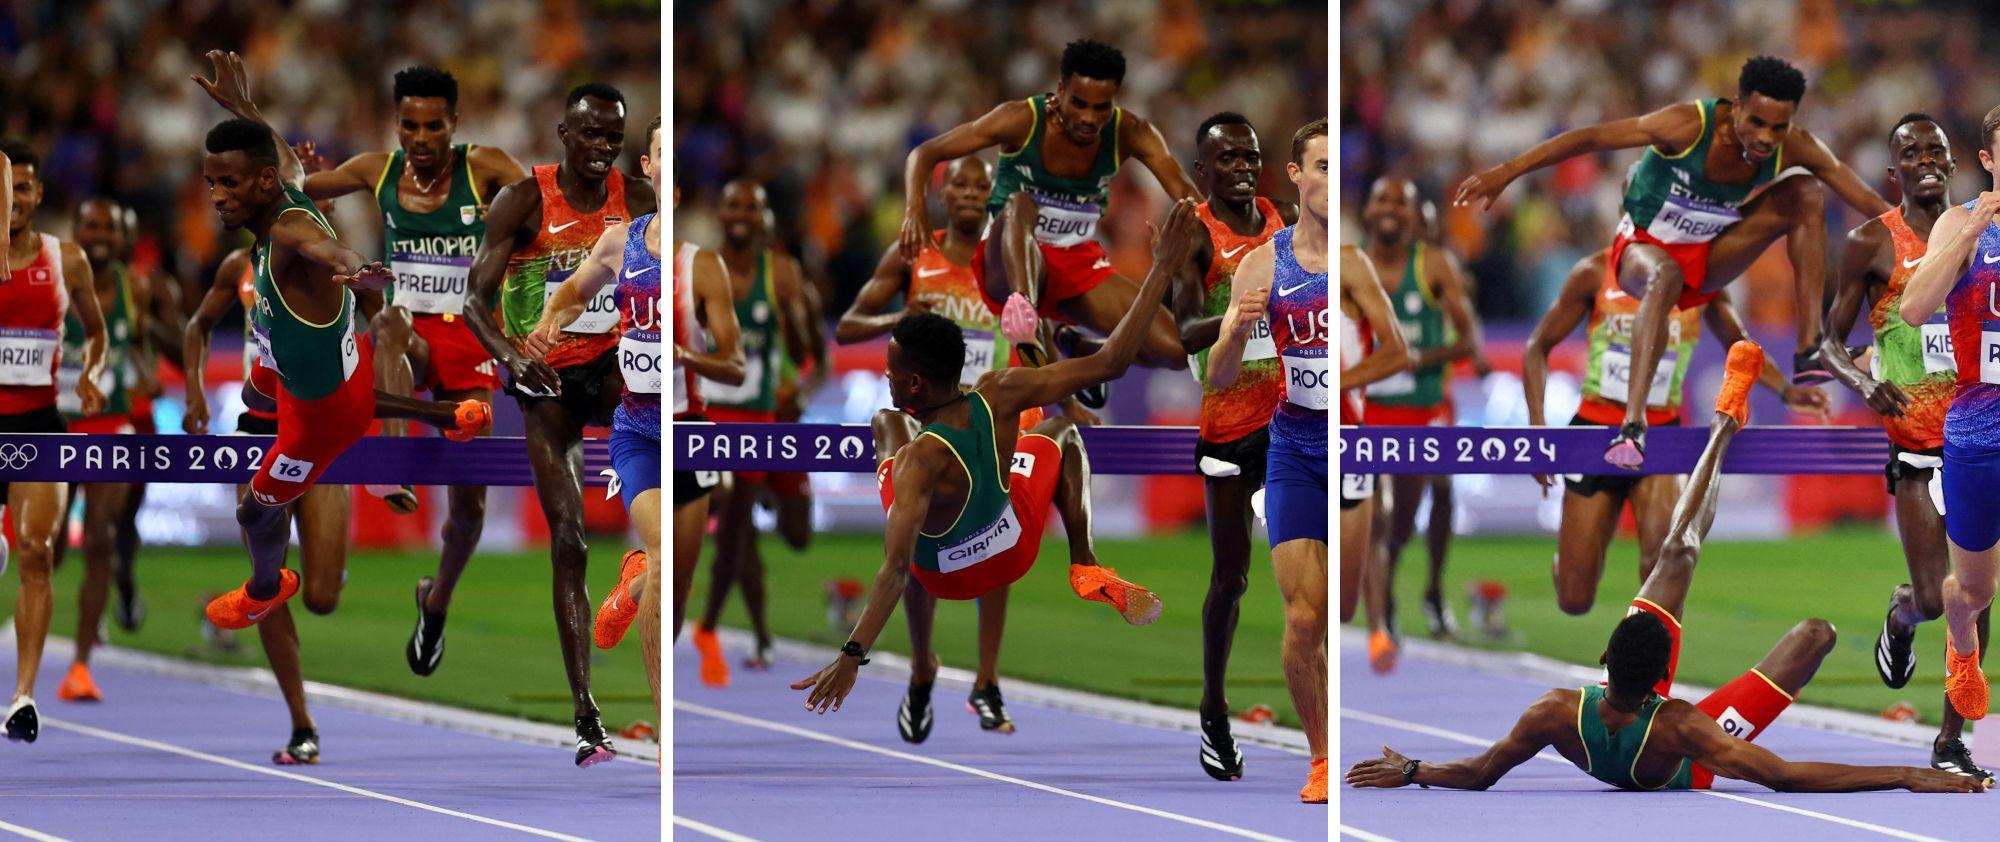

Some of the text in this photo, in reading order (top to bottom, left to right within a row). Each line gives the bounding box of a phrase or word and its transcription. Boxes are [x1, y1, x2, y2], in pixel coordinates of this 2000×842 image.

[399, 272, 465, 295] FIREWU
[0, 347, 44, 366] AZIRI
[188, 446, 263, 470] 202
[279, 462, 302, 477] 16
